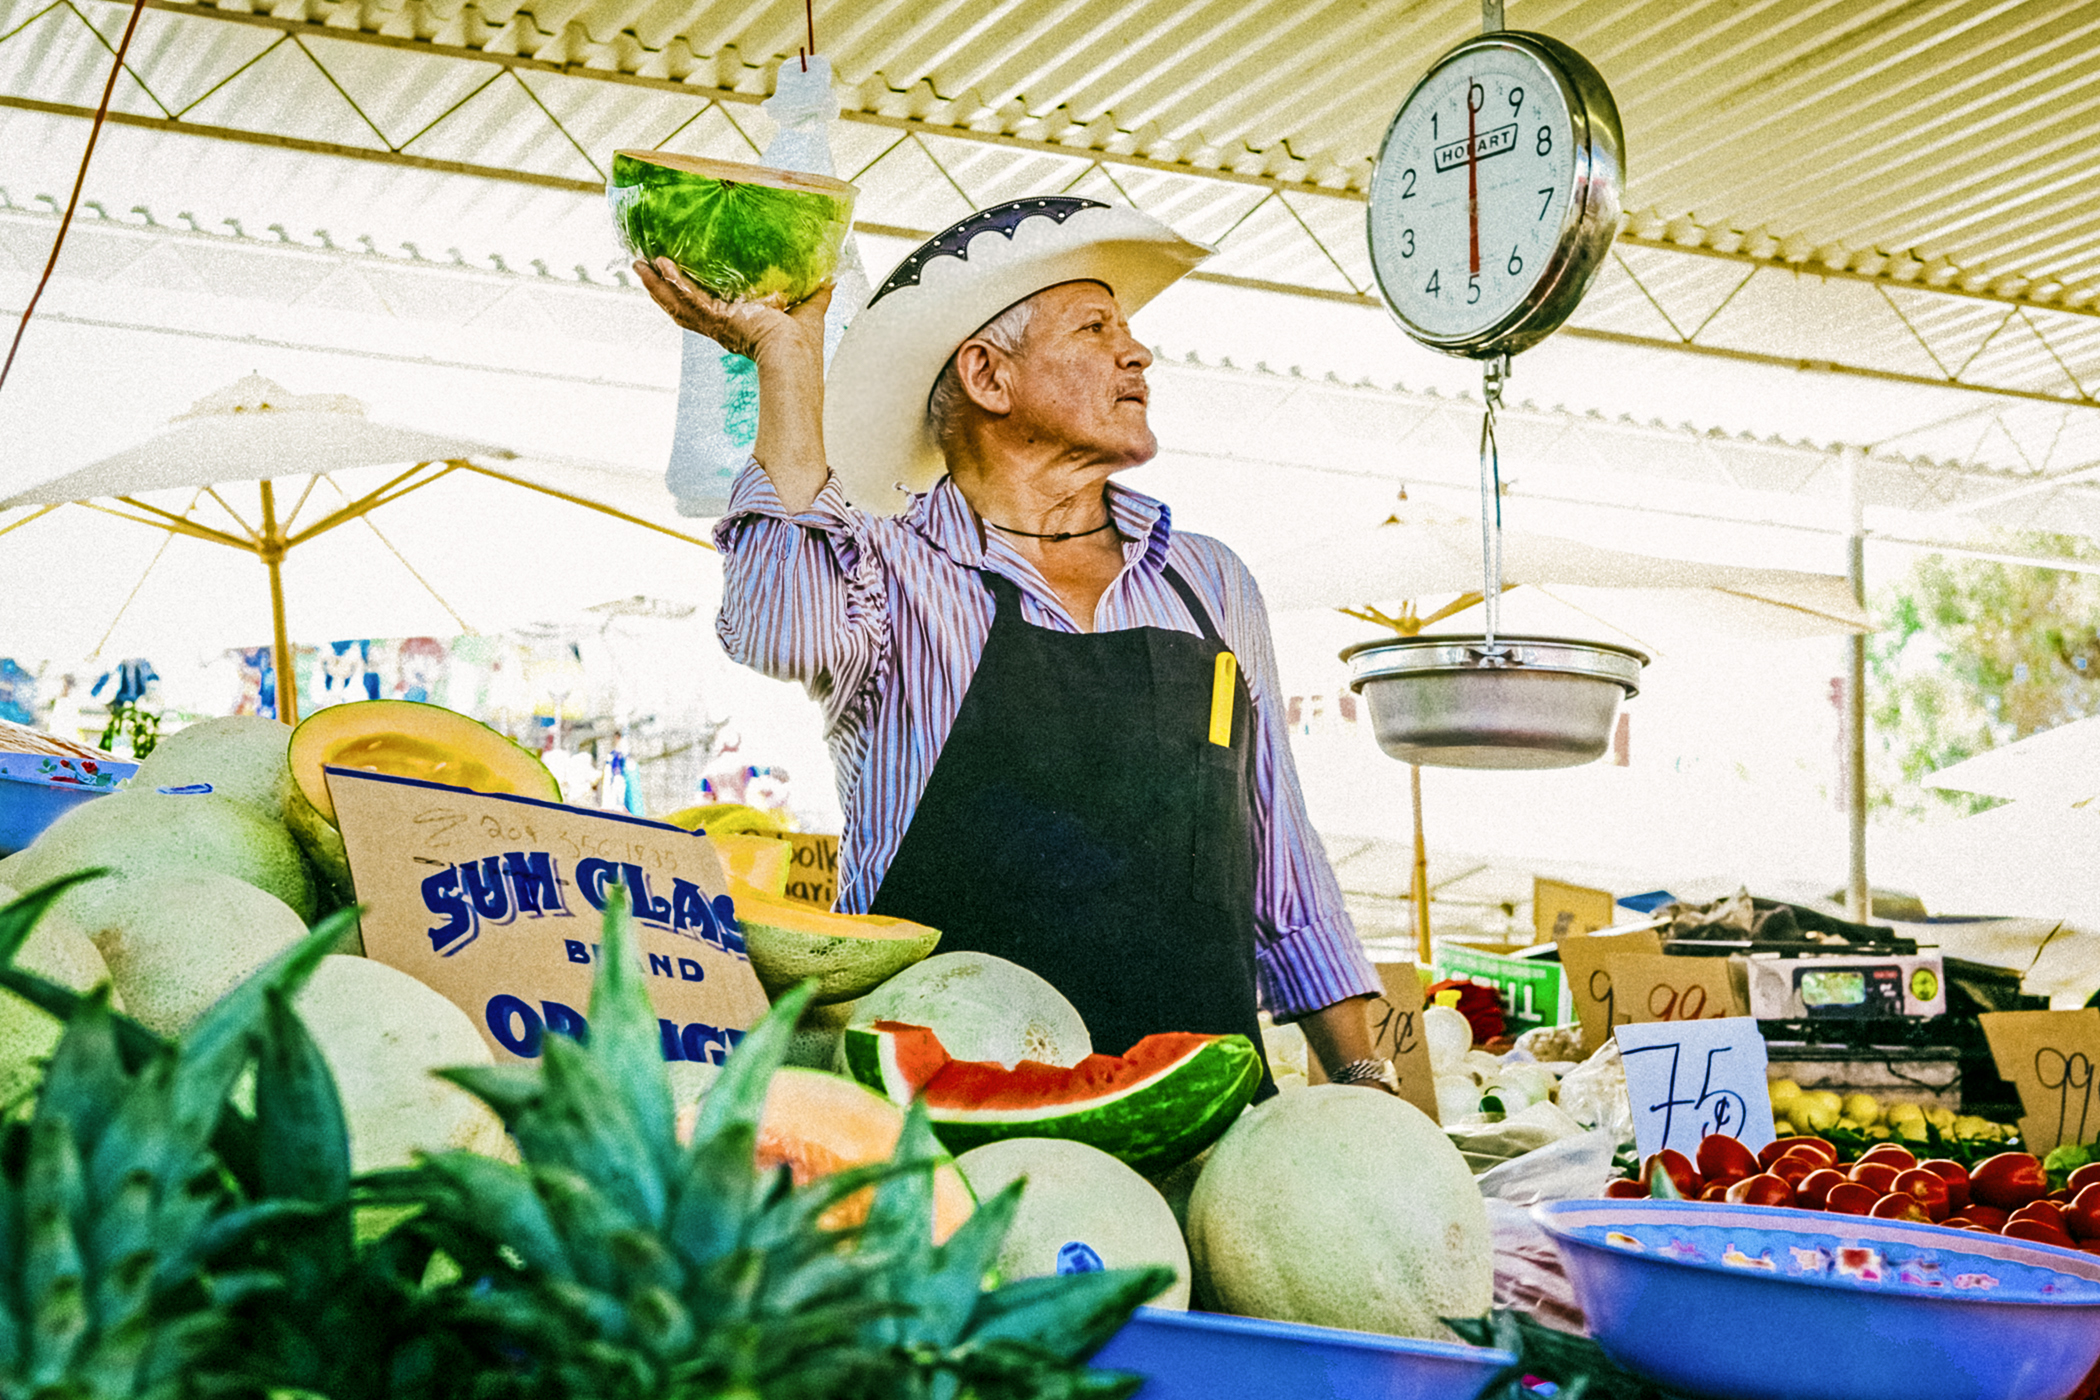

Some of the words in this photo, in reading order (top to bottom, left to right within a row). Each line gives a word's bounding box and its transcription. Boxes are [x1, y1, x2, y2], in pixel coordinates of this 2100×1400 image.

[1508, 87, 1524, 118] 9
[1431, 111, 1438, 140] 1
[1536, 125, 1552, 157] 8
[1442, 130, 1510, 163] HOART
[1402, 168, 1416, 199] 2
[1538, 187, 1554, 221] 7
[1401, 229, 1415, 258] 3
[1508, 244, 1523, 275] 6
[1425, 268, 1441, 298] 4
[1467, 273, 1480, 304] 5
[564, 938, 705, 982] BND
[2034, 1046, 2100, 1148] 99
